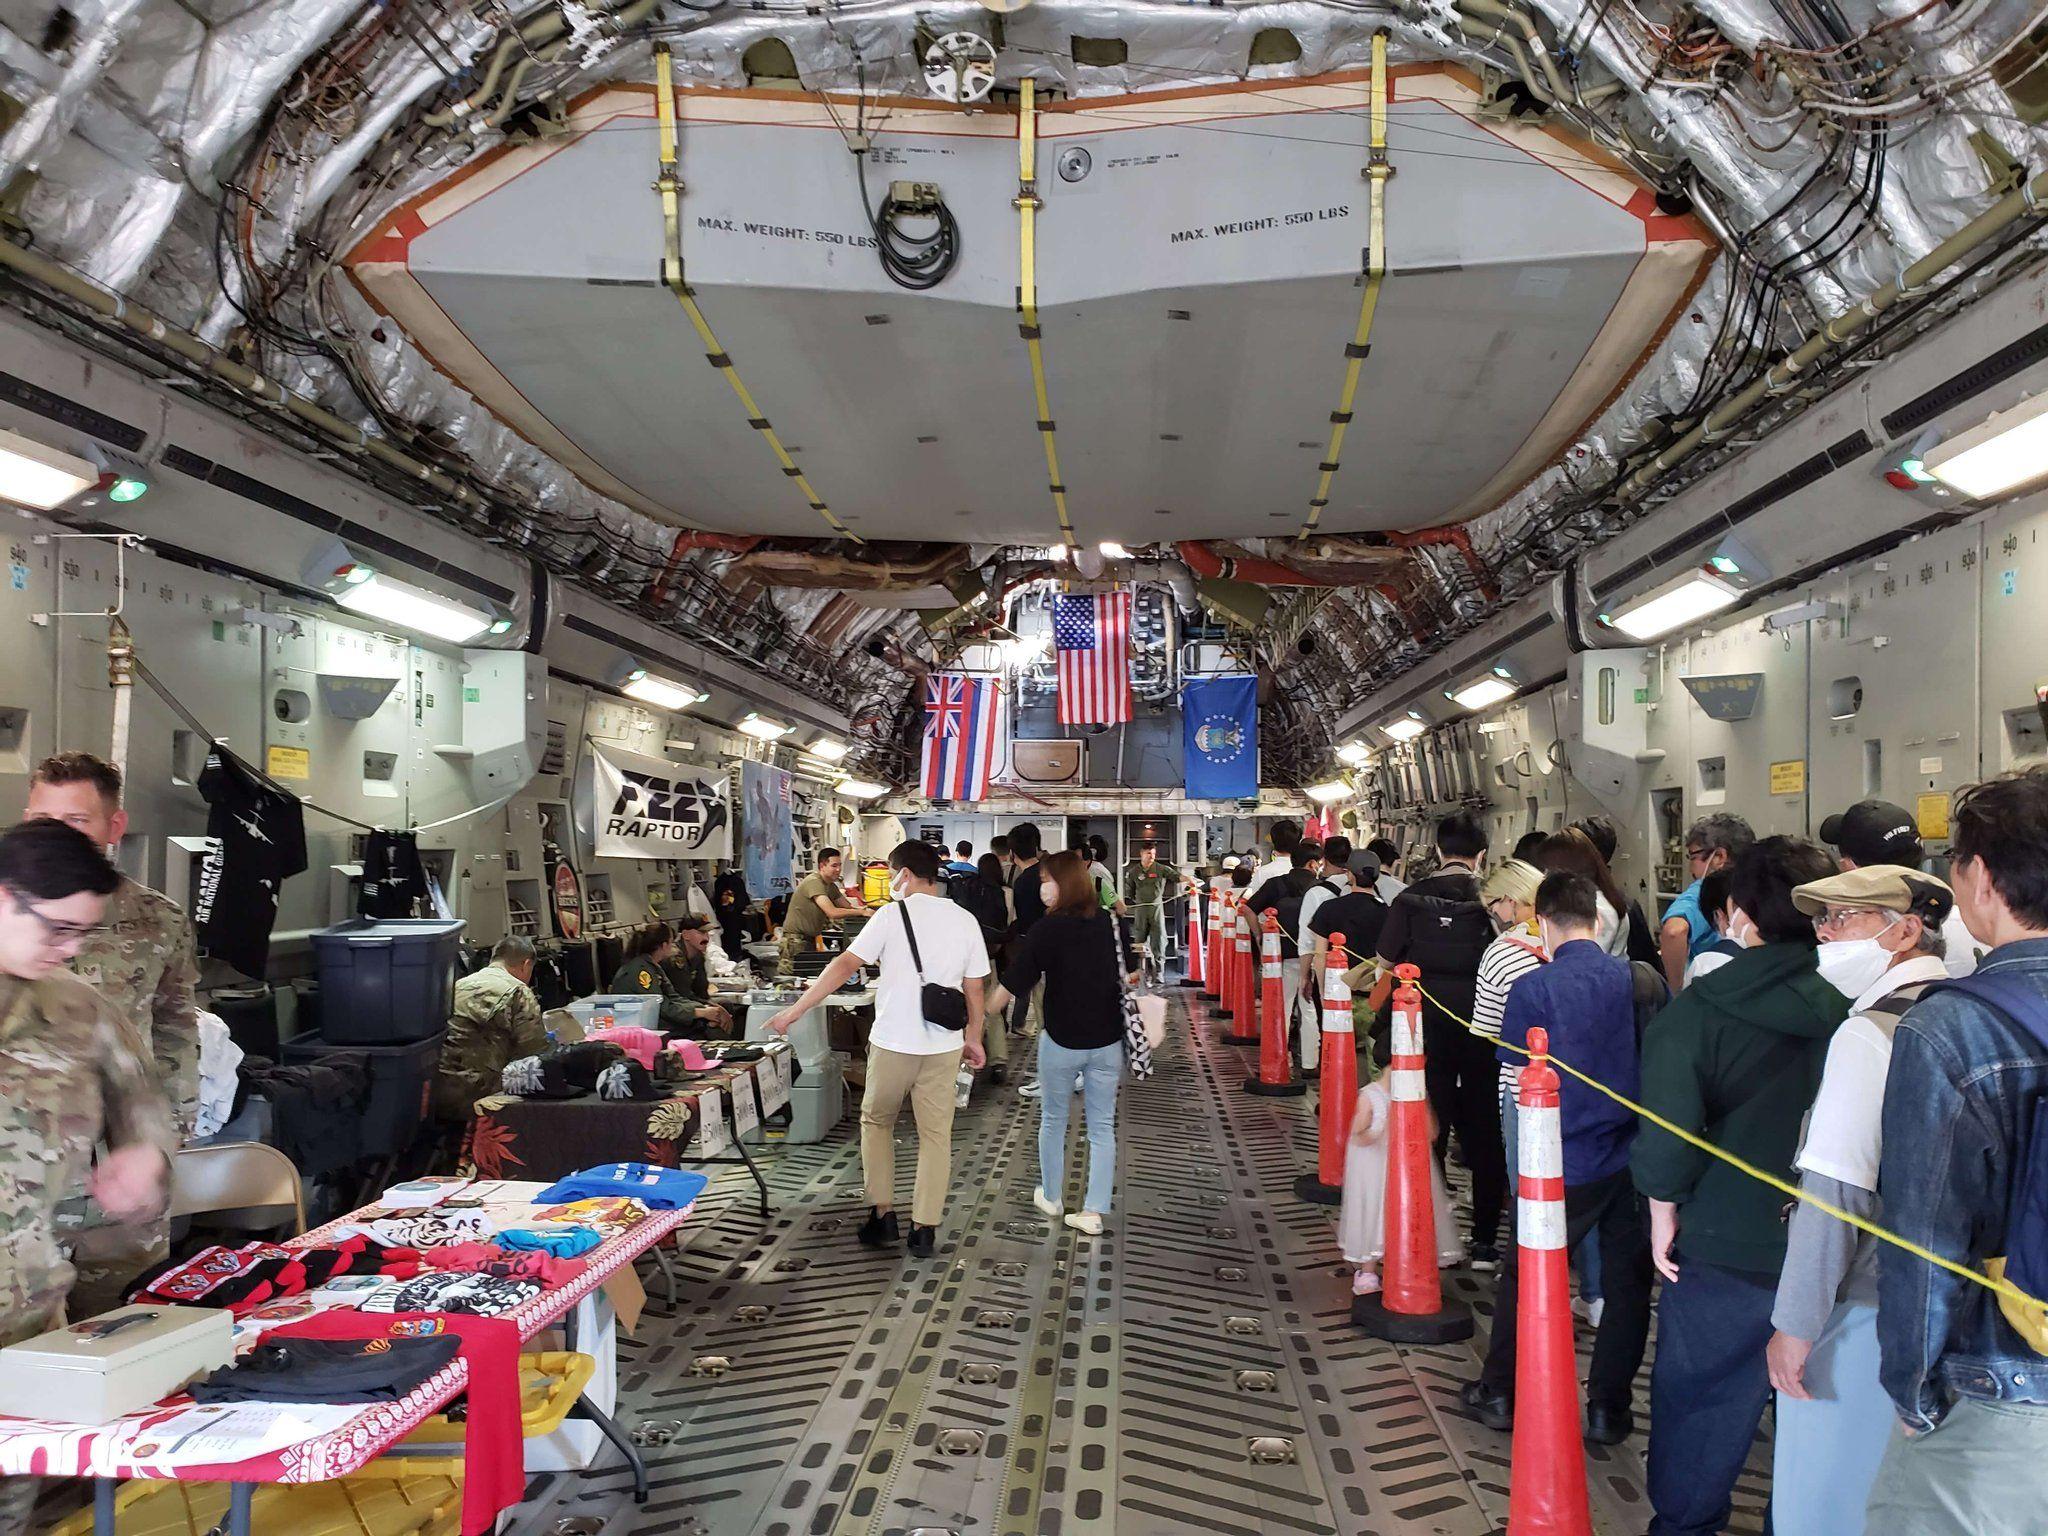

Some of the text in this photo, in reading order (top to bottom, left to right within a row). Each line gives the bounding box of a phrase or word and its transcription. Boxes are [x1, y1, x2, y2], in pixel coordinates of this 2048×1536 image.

[697, 216, 878, 249] MAX. WEIGHT: 550 LBS
[1171, 205, 1349, 243] MAX. WEIGHT: 550 LBS
[606, 818, 702, 841] RAPTOR
[199, 906, 212, 924] AIR
